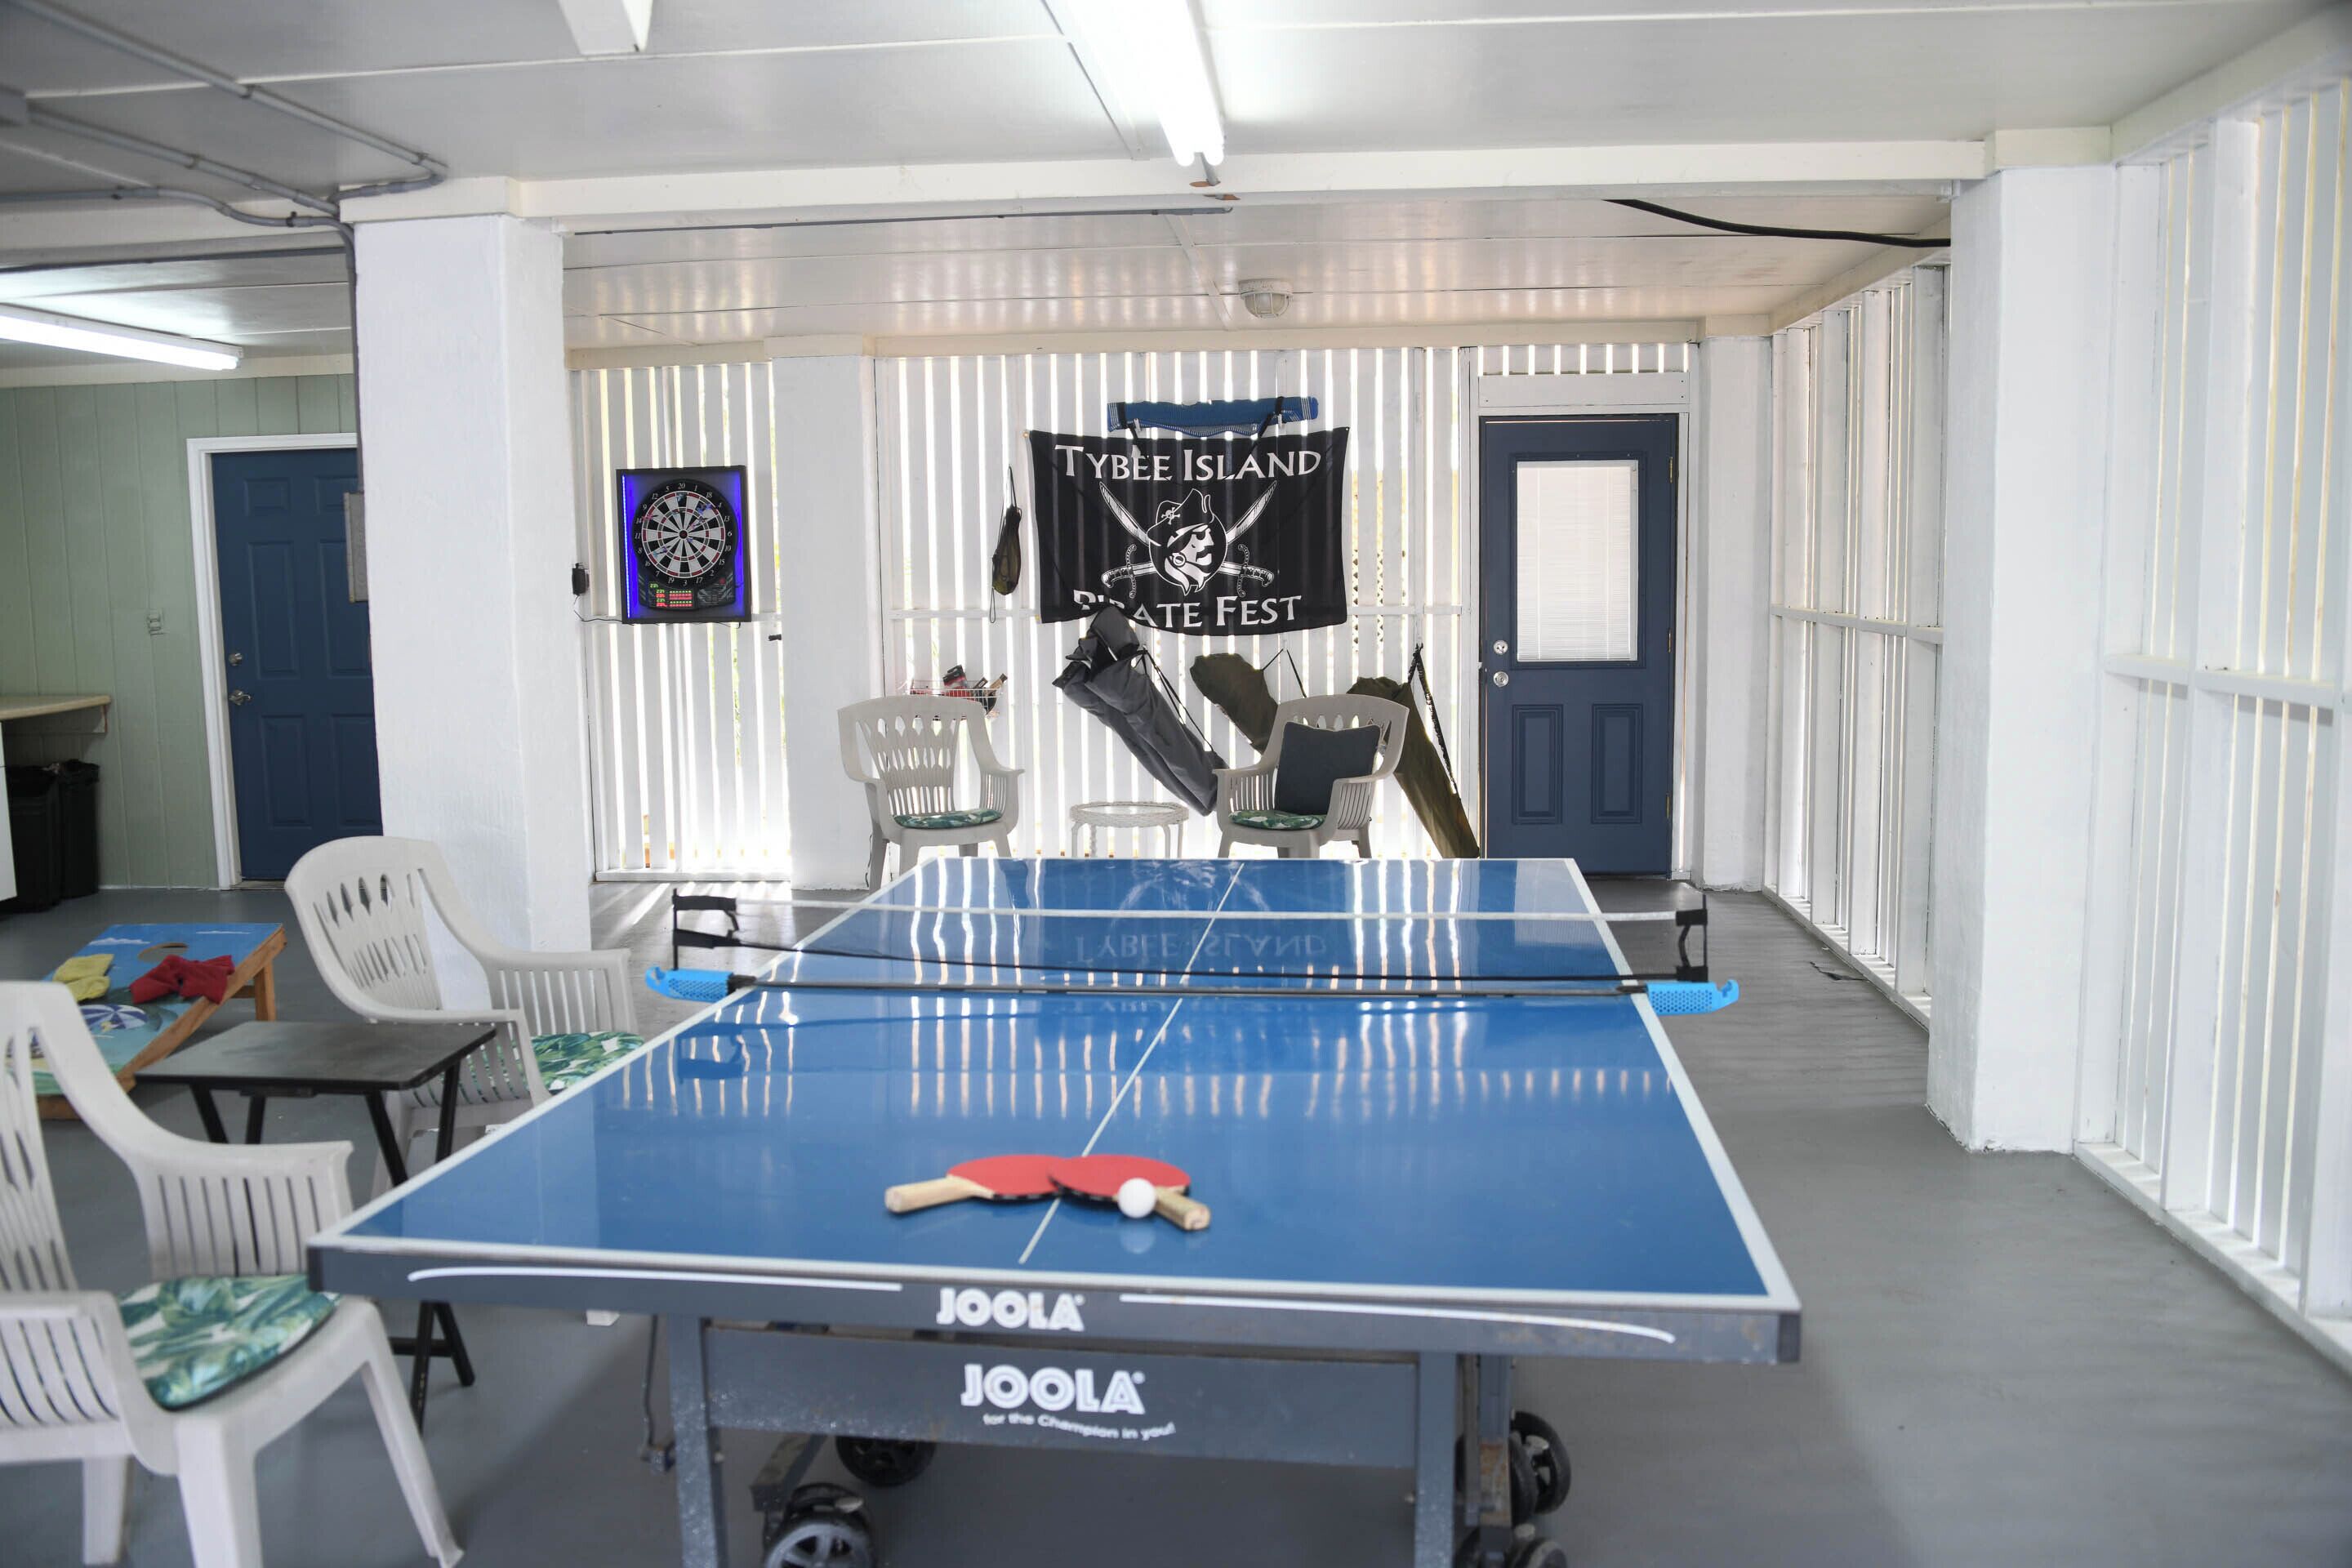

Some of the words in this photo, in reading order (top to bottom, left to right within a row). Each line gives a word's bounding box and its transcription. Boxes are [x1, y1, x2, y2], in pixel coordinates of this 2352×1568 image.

[1054, 444, 1173, 482] TYBEE
[1183, 448, 1322, 482] ISLAND
[1215, 595, 1303, 626] FEST
[936, 1287, 1085, 1332] JOOLA
[960, 1363, 1146, 1415] JOOLA
[982, 1413, 1005, 1426] for
[1008, 1412, 1035, 1425] the
[1037, 1414, 1120, 1439] Champion
[1121, 1427, 1138, 1440] in
